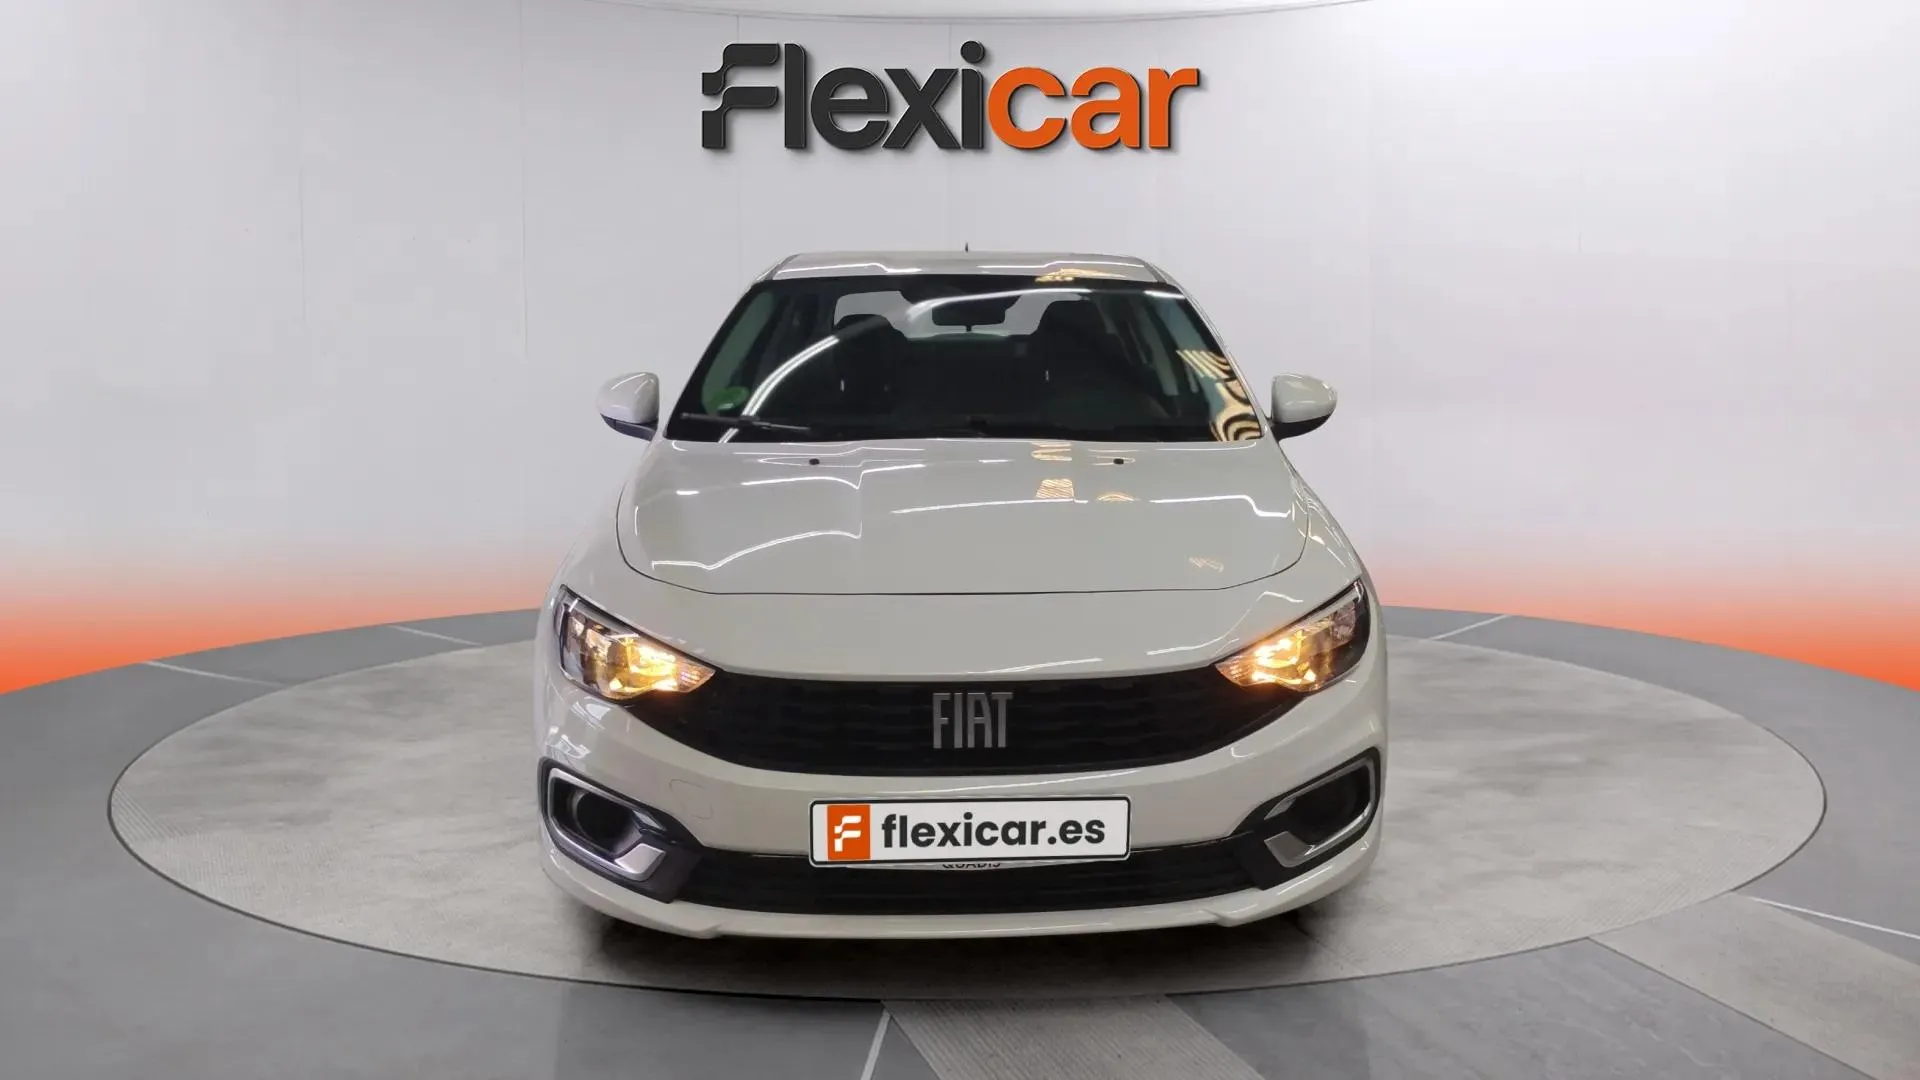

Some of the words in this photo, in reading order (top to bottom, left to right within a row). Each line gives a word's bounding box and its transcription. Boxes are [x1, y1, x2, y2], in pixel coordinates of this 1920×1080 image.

[702, 40, 1200, 150] Flexicar
[933, 692, 1013, 749] FIAT
[881, 811, 1106, 849] flexicar.es
